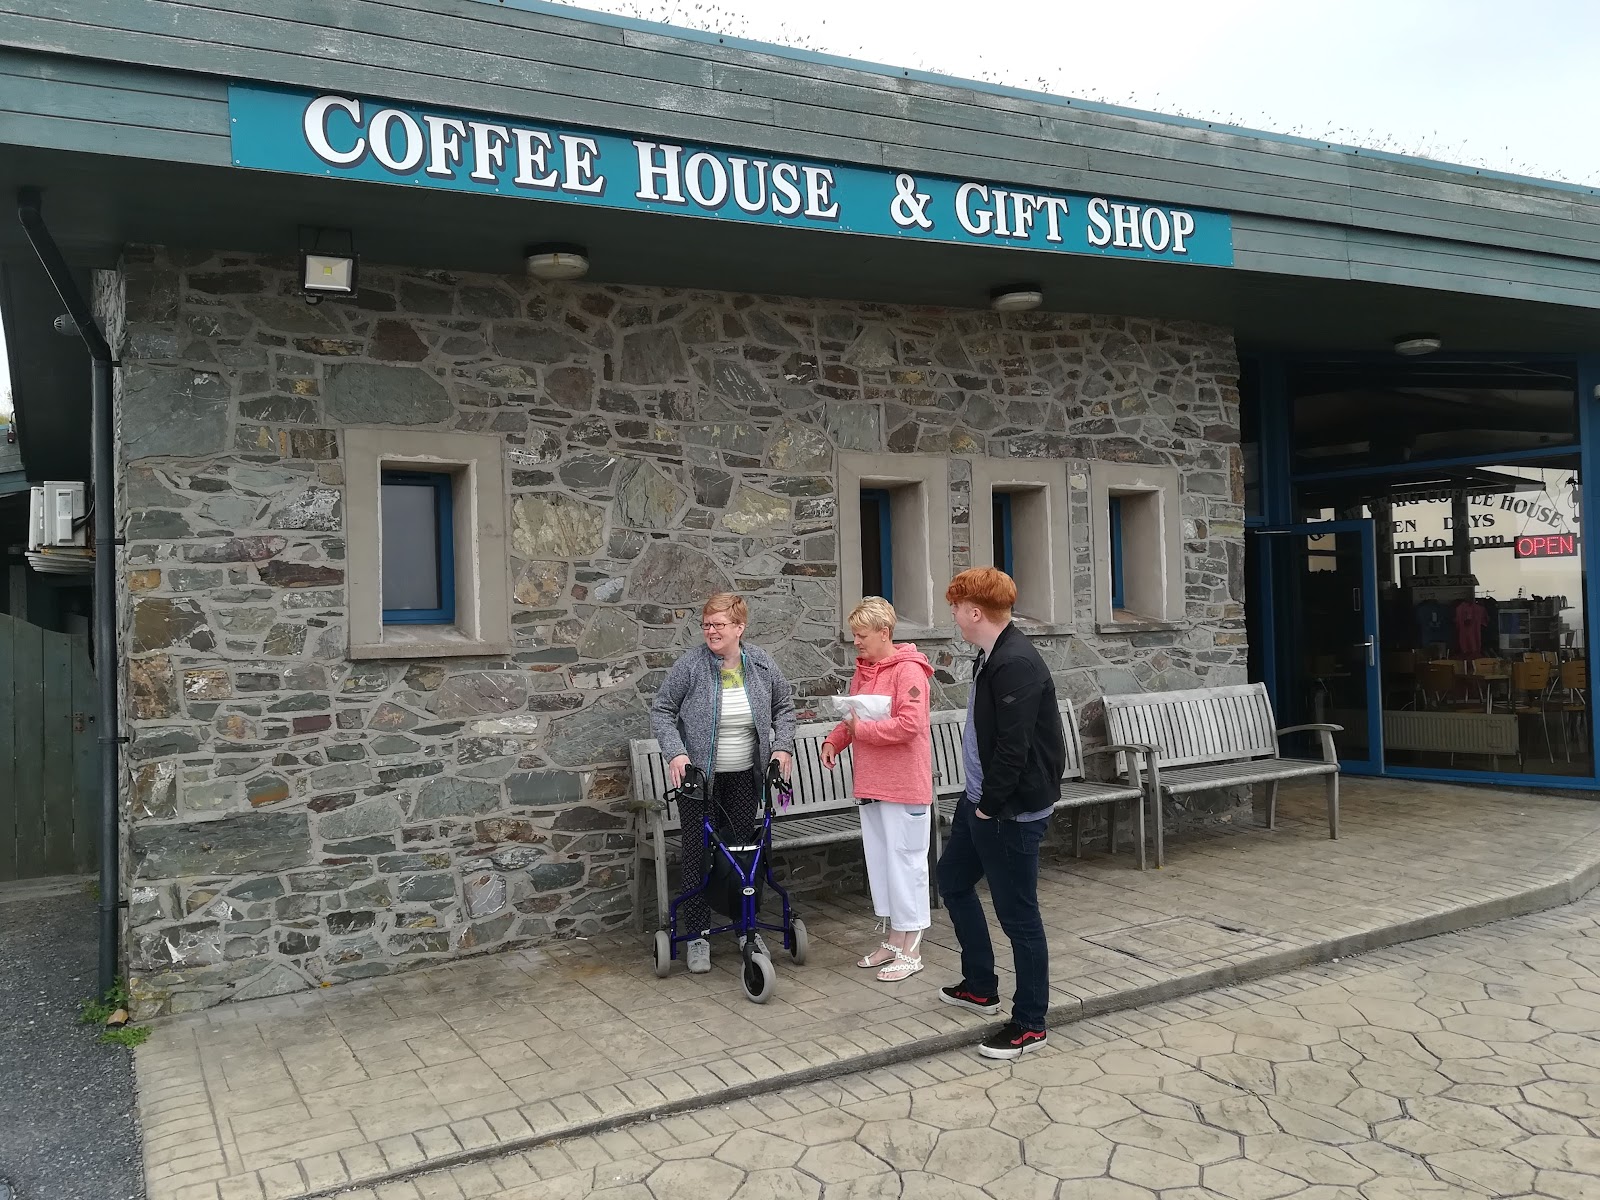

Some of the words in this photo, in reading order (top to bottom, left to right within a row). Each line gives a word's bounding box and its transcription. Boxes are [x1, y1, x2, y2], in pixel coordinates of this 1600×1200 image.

[303, 95, 605, 195] COFFEE
[632, 138, 840, 221] HOUSE
[889, 173, 934, 230] &
[955, 182, 1069, 243] GIFT
[1087, 197, 1195, 254] SHOP
[1424, 488, 1496, 508] COFFEE
[1500, 494, 1565, 529] HOUSE
[1442, 513, 1497, 531] DAYS
[1423, 535, 1447, 551] to
[1517, 535, 1574, 556] OPEN
